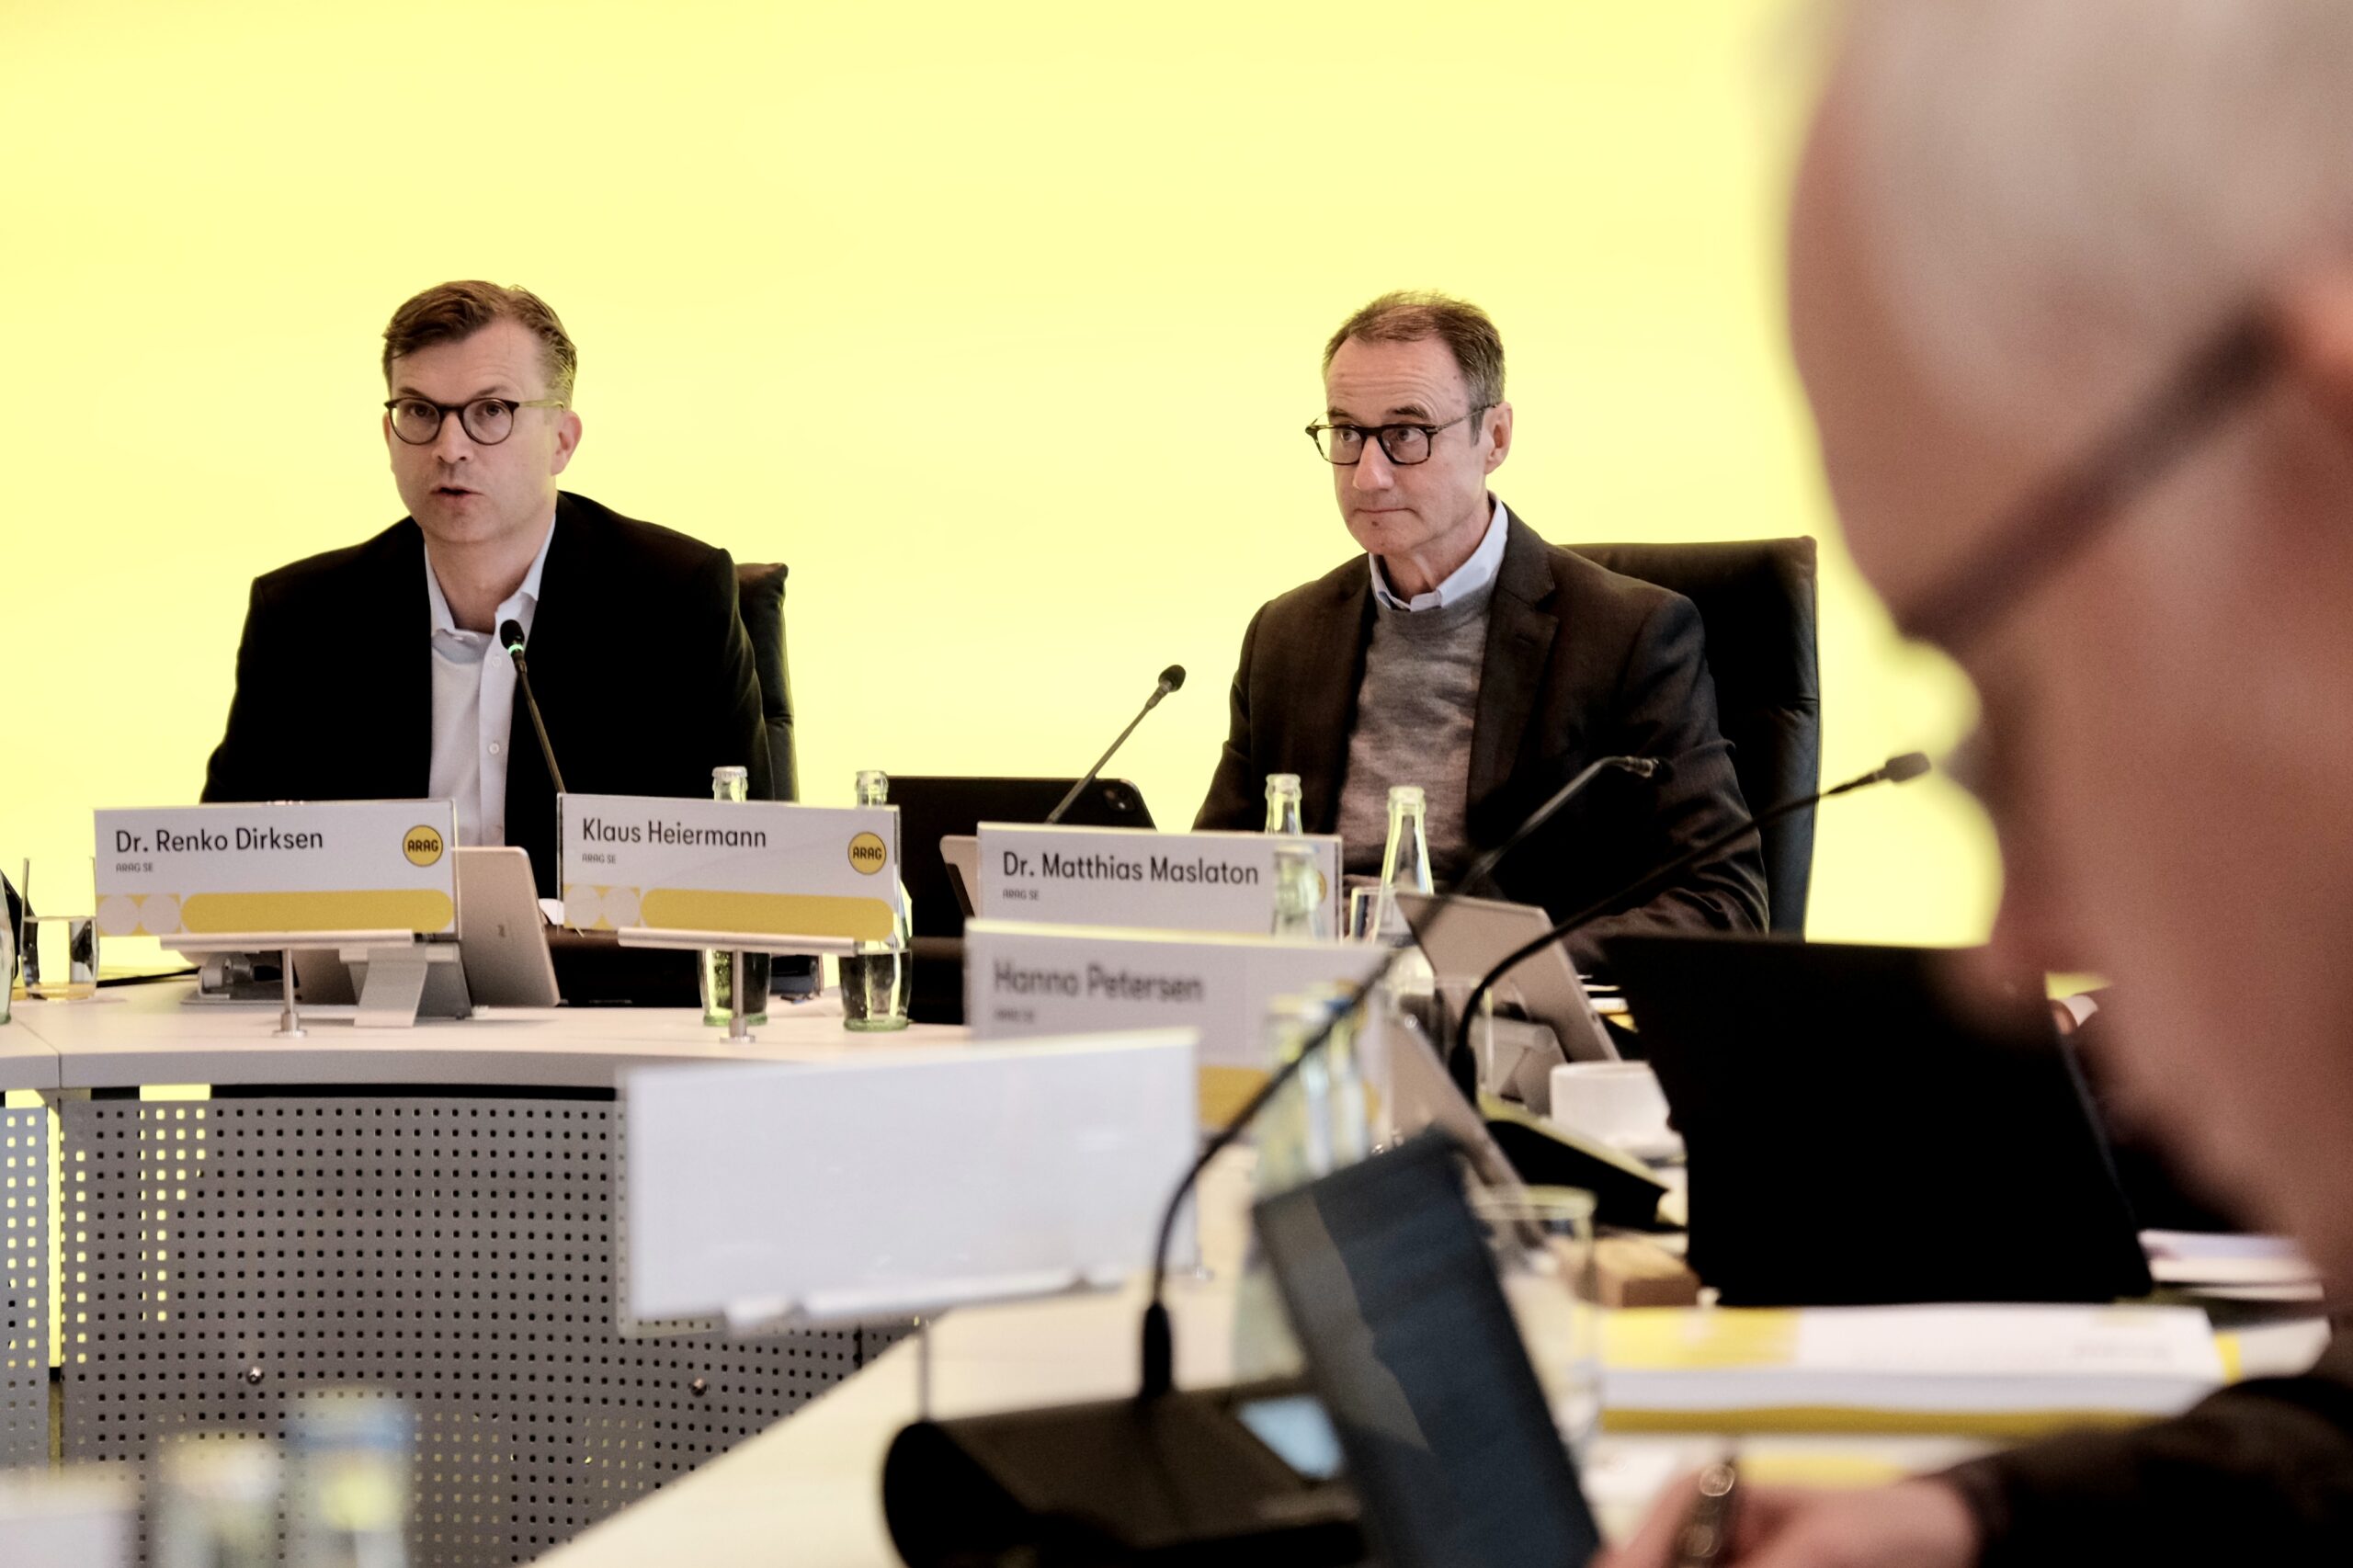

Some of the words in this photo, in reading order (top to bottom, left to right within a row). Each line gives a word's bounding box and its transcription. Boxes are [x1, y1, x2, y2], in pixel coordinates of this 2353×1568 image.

[583, 817, 642, 843] Klaus
[648, 820, 767, 847] Heiermann
[116, 830, 149, 853] Dr.
[155, 828, 228, 852] Renko
[235, 826, 323, 850] Dirksen
[407, 839, 439, 852] ARAG
[582, 853, 607, 864] ARAG
[607, 853, 617, 864] SE
[852, 846, 883, 860] ARAG
[115, 862, 142, 873] ARAG
[142, 862, 153, 872] SE
[1003, 850, 1035, 877] Dr.
[1041, 852, 1143, 881] Matthias
[1150, 856, 1259, 884] Maslaton
